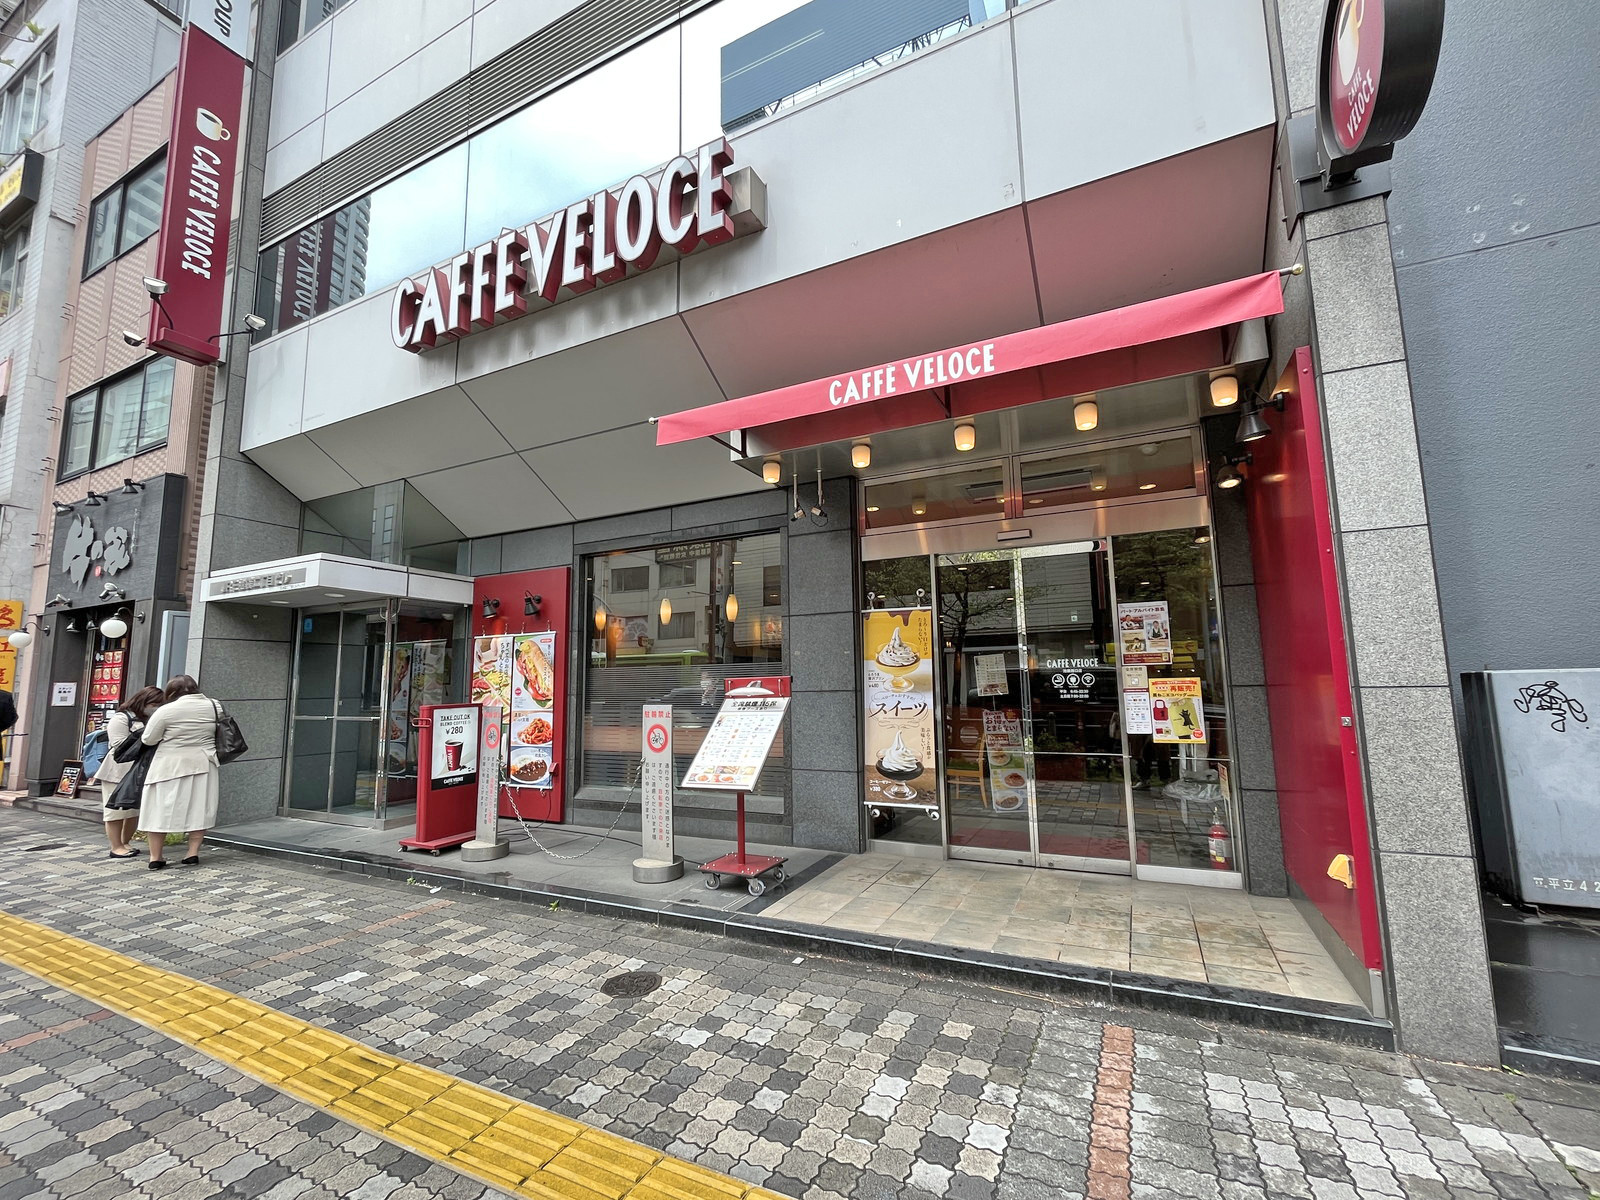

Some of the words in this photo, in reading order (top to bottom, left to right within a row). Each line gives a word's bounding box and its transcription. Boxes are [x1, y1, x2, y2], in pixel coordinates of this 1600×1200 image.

[525, 137, 735, 303] VELOCE
[182, 206, 216, 280] VELOCE
[903, 343, 995, 389] VELOCE
[1070, 658, 1099, 668] VELOCE
[644, 710, 671, 719] 駐輪禁止
[868, 700, 928, 718] スイーツ
[445, 726, 464, 735] ¥280
